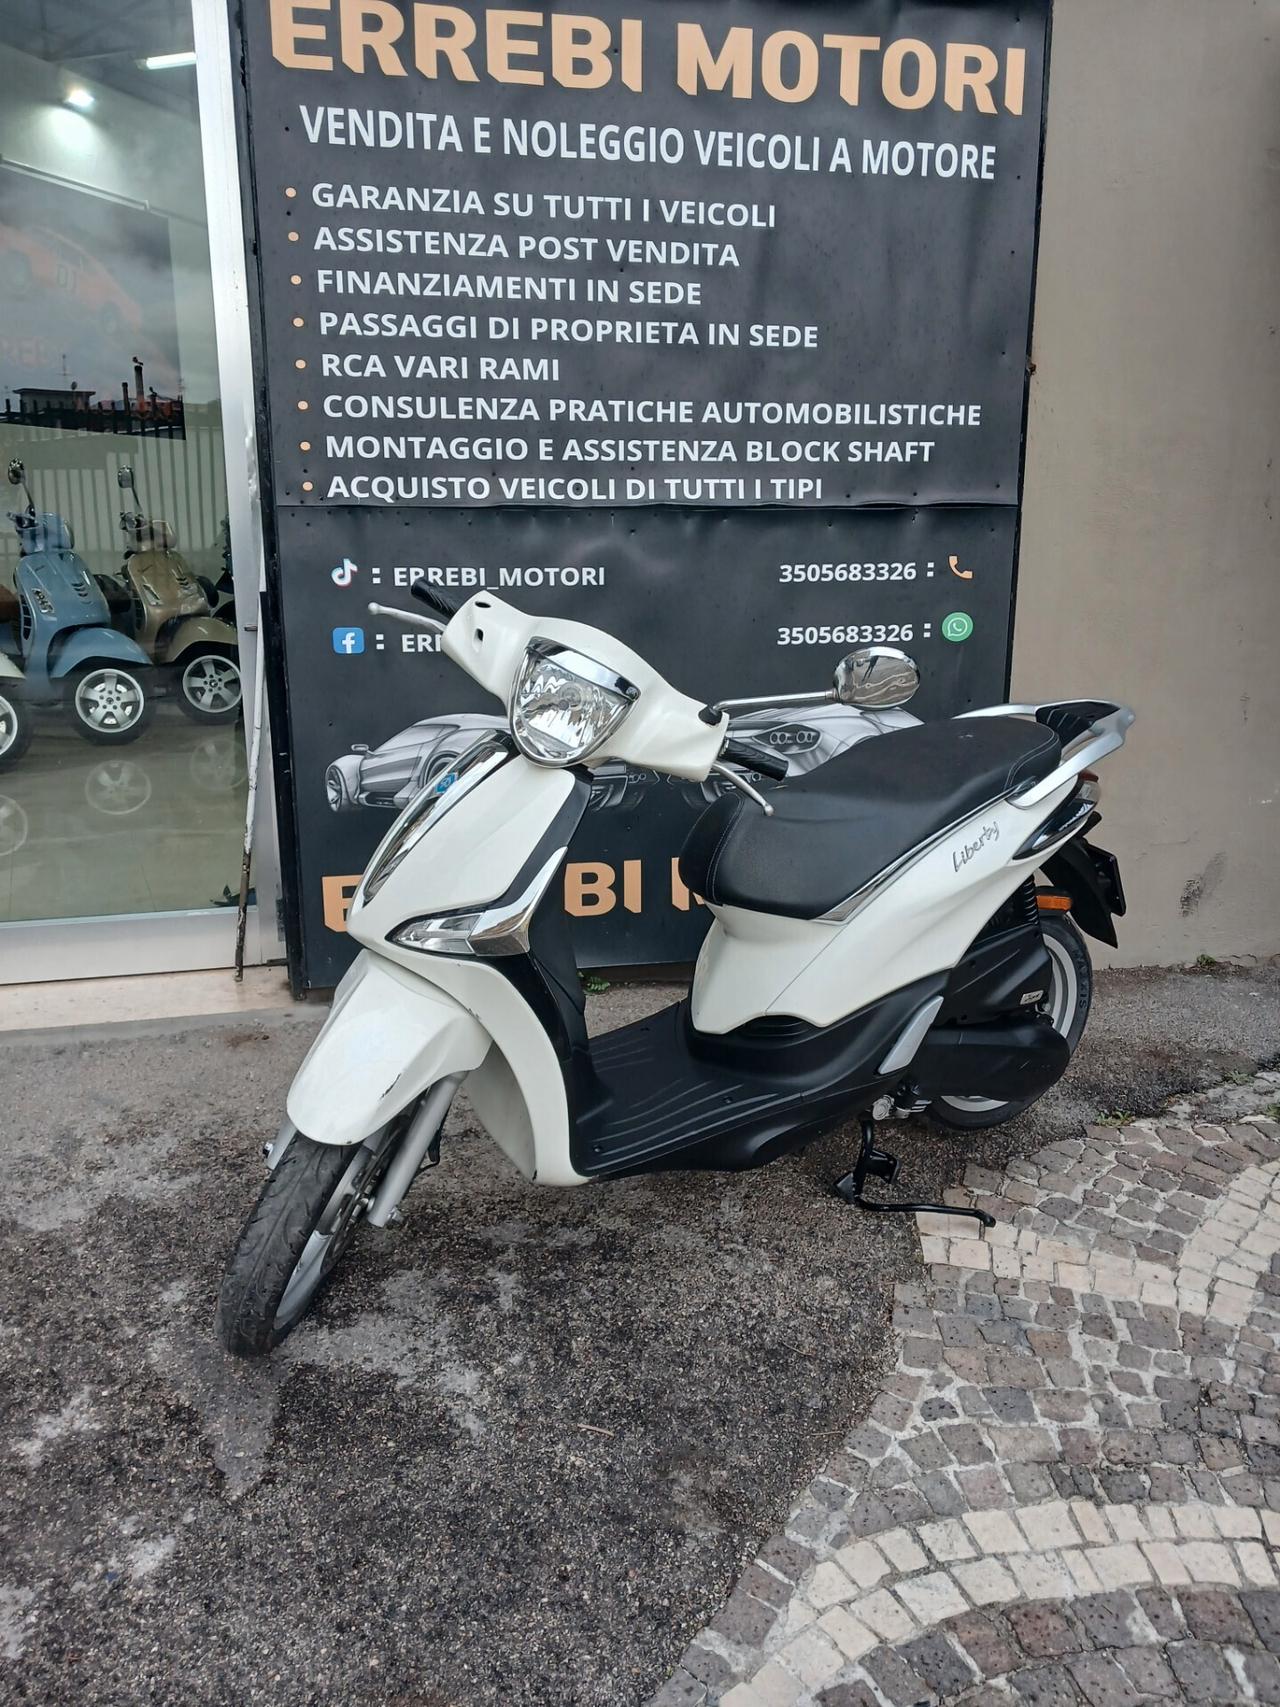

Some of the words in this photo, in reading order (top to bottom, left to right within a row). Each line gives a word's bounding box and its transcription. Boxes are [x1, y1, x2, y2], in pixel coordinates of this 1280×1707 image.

[270, 0, 642, 92] ERREBI
[677, 23, 1025, 115] MOTORI
[299, 105, 463, 152] VENDITA
[474, 117, 491, 153] E
[504, 118, 684, 163] NOLEGGIO
[694, 130, 819, 171] VEICOLI
[829, 138, 852, 172] A
[862, 140, 995, 179] MOTORE
[313, 183, 485, 214] GARANZIA
[494, 193, 533, 216] SU
[544, 195, 631, 220] TUTTI
[643, 199, 649, 222] I
[659, 200, 775, 227] VEICOLI
[314, 227, 509, 257] ASSISTENZA
[519, 236, 598, 260] POST
[606, 239, 739, 266] VENDITA
[318, 270, 575, 300] FINANZIAMENTI
[588, 279, 618, 302] IN
[629, 281, 701, 304] SEDE
[320, 312, 476, 338] PASSAGGI
[489, 317, 519, 339] DI
[532, 318, 699, 344] PROPRIETA
[709, 324, 739, 345] IN
[750, 325, 817, 347] SEDE
[322, 354, 386, 377] RCA
[394, 356, 468, 379] VARI
[480, 358, 559, 380] RAMI
[324, 395, 540, 420] CONSULENZA
[550, 399, 693, 422] PRATICHE
[702, 402, 981, 425] AUTOMOBILISTICHE
[327, 436, 528, 460] MONTAGGIO
[539, 439, 553, 460] E
[562, 439, 737, 461] ASSISTENZA
[747, 441, 840, 462] BLOCK
[848, 441, 935, 462] SHAFT
[327, 476, 490, 503] ACQUISTO
[499, 478, 615, 500] VEICOLI
[627, 479, 654, 499] DI
[664, 479, 744, 499] TUTTI
[756, 479, 761, 499] I
[770, 479, 821, 499] TIPI
[779, 563, 916, 582] 3505683326
[777, 624, 913, 645] 3505683326
[952, 821, 1000, 872] Liberty
